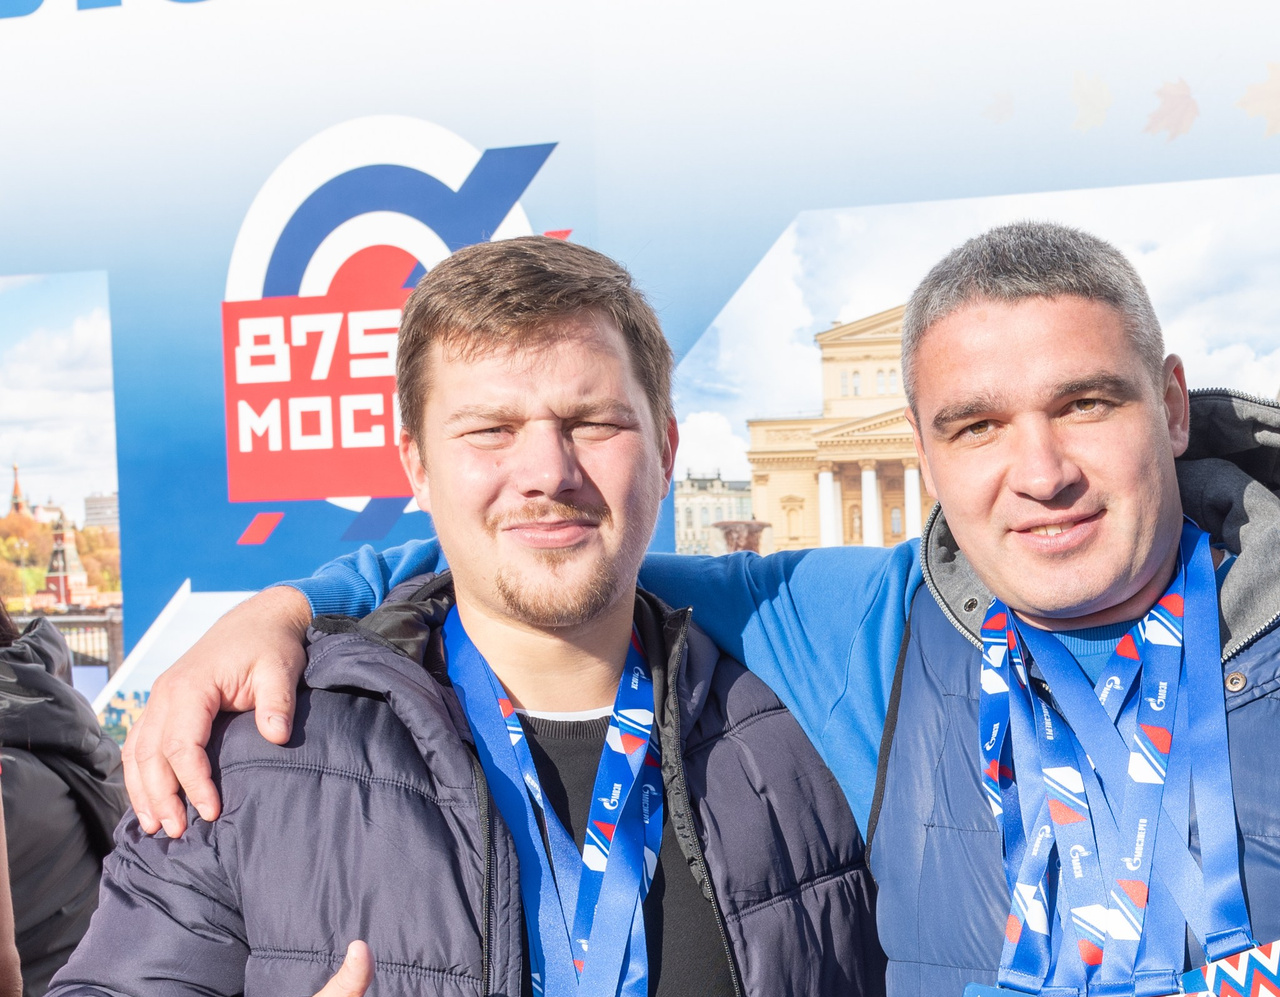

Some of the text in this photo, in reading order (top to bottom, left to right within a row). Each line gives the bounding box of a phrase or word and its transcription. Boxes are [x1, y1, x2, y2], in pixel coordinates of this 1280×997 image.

[235, 309, 402, 384] 875
[237, 393, 400, 453] МОС
[1157, 681, 1168, 700] МОЭК
[611, 783, 622, 800] МОЭК
[1134, 818, 1148, 858] МОСЭНЕРГО
[1072, 858, 1084, 879] МОЭК
